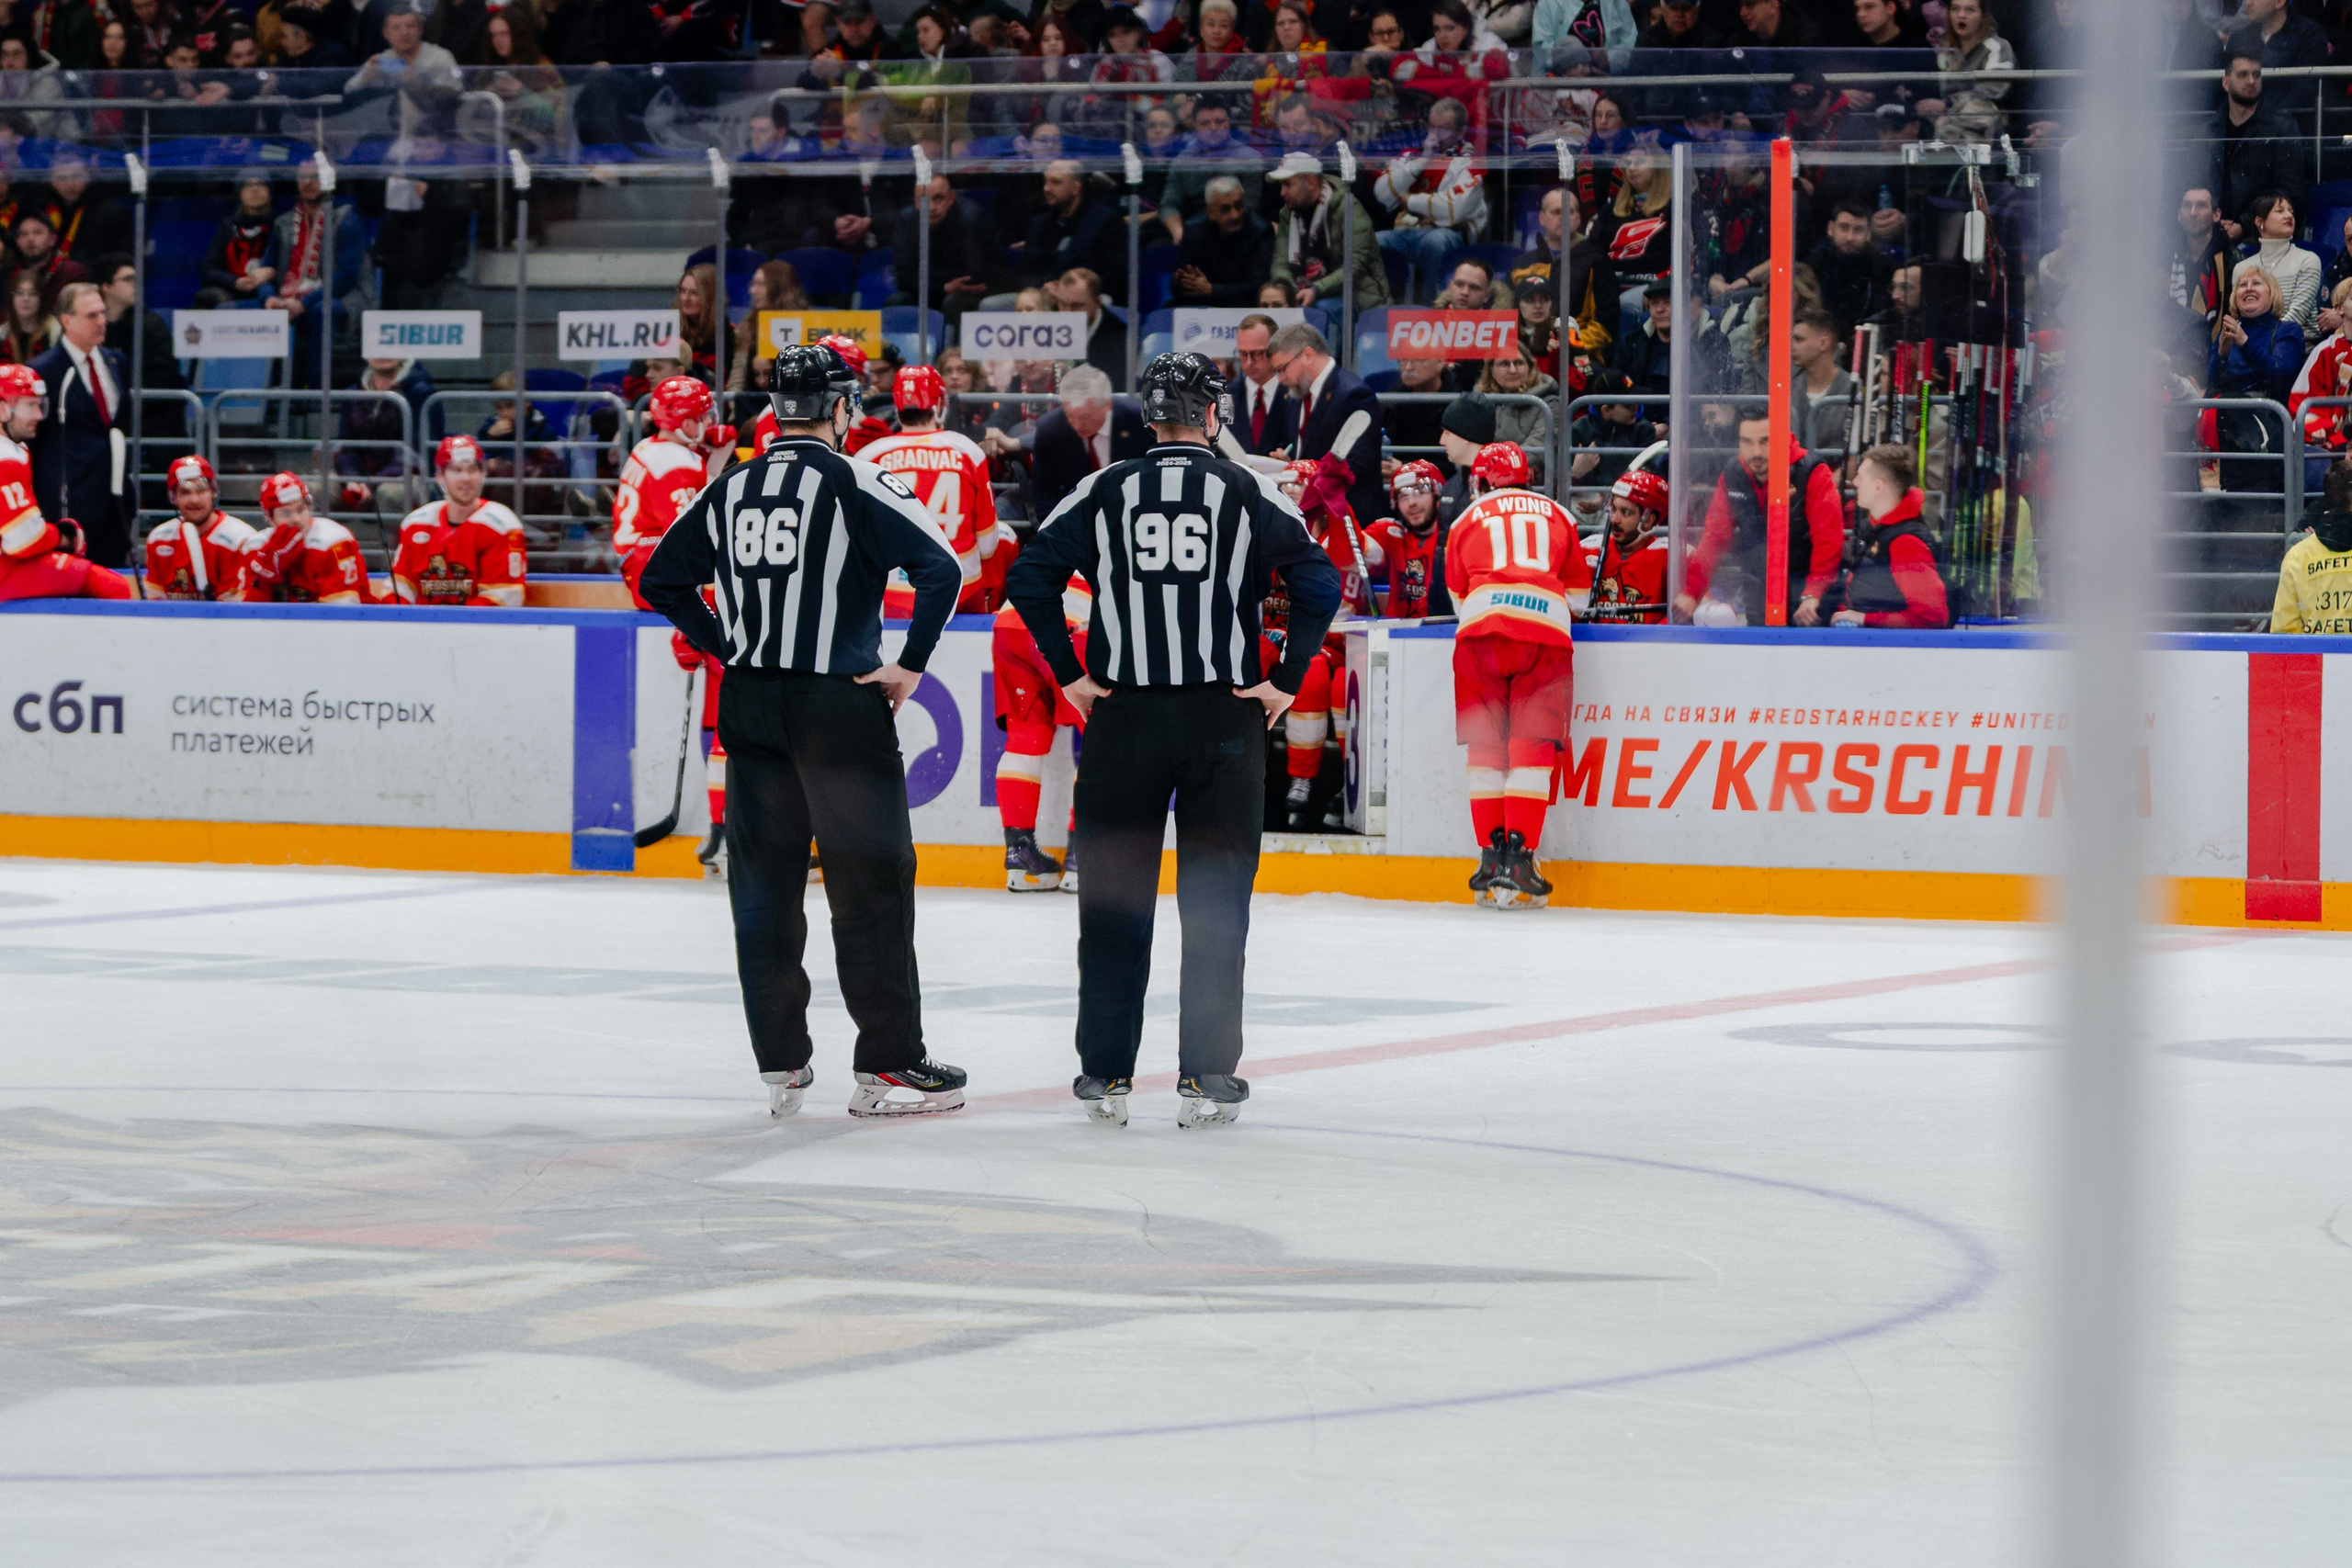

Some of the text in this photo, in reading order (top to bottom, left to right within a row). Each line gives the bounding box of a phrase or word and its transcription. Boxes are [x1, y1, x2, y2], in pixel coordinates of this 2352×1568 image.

[379, 323, 464, 345] SIBUR
[566, 321, 673, 348] KHL.RU
[975, 324, 1073, 348] согаз
[1390, 321, 1516, 348] FONBET
[1, 481, 29, 510] 12
[880, 473, 910, 496] 8
[614, 484, 642, 546] 2
[1472, 496, 1553, 520] A. WONG
[735, 507, 799, 567] 86
[1134, 513, 1208, 571] 96
[1482, 513, 1550, 572] 10
[2307, 556, 2352, 575] SAFET
[1490, 592, 1549, 614] SIBUR
[14, 681, 435, 735] сбп система быстрых
[1574, 704, 1611, 723] ГДА
[1624, 705, 1651, 722] НА
[1664, 705, 1737, 724] СВЯЗИ
[1748, 707, 1960, 728] #REDSTARHOCKEY
[172, 726, 314, 756] платежей
